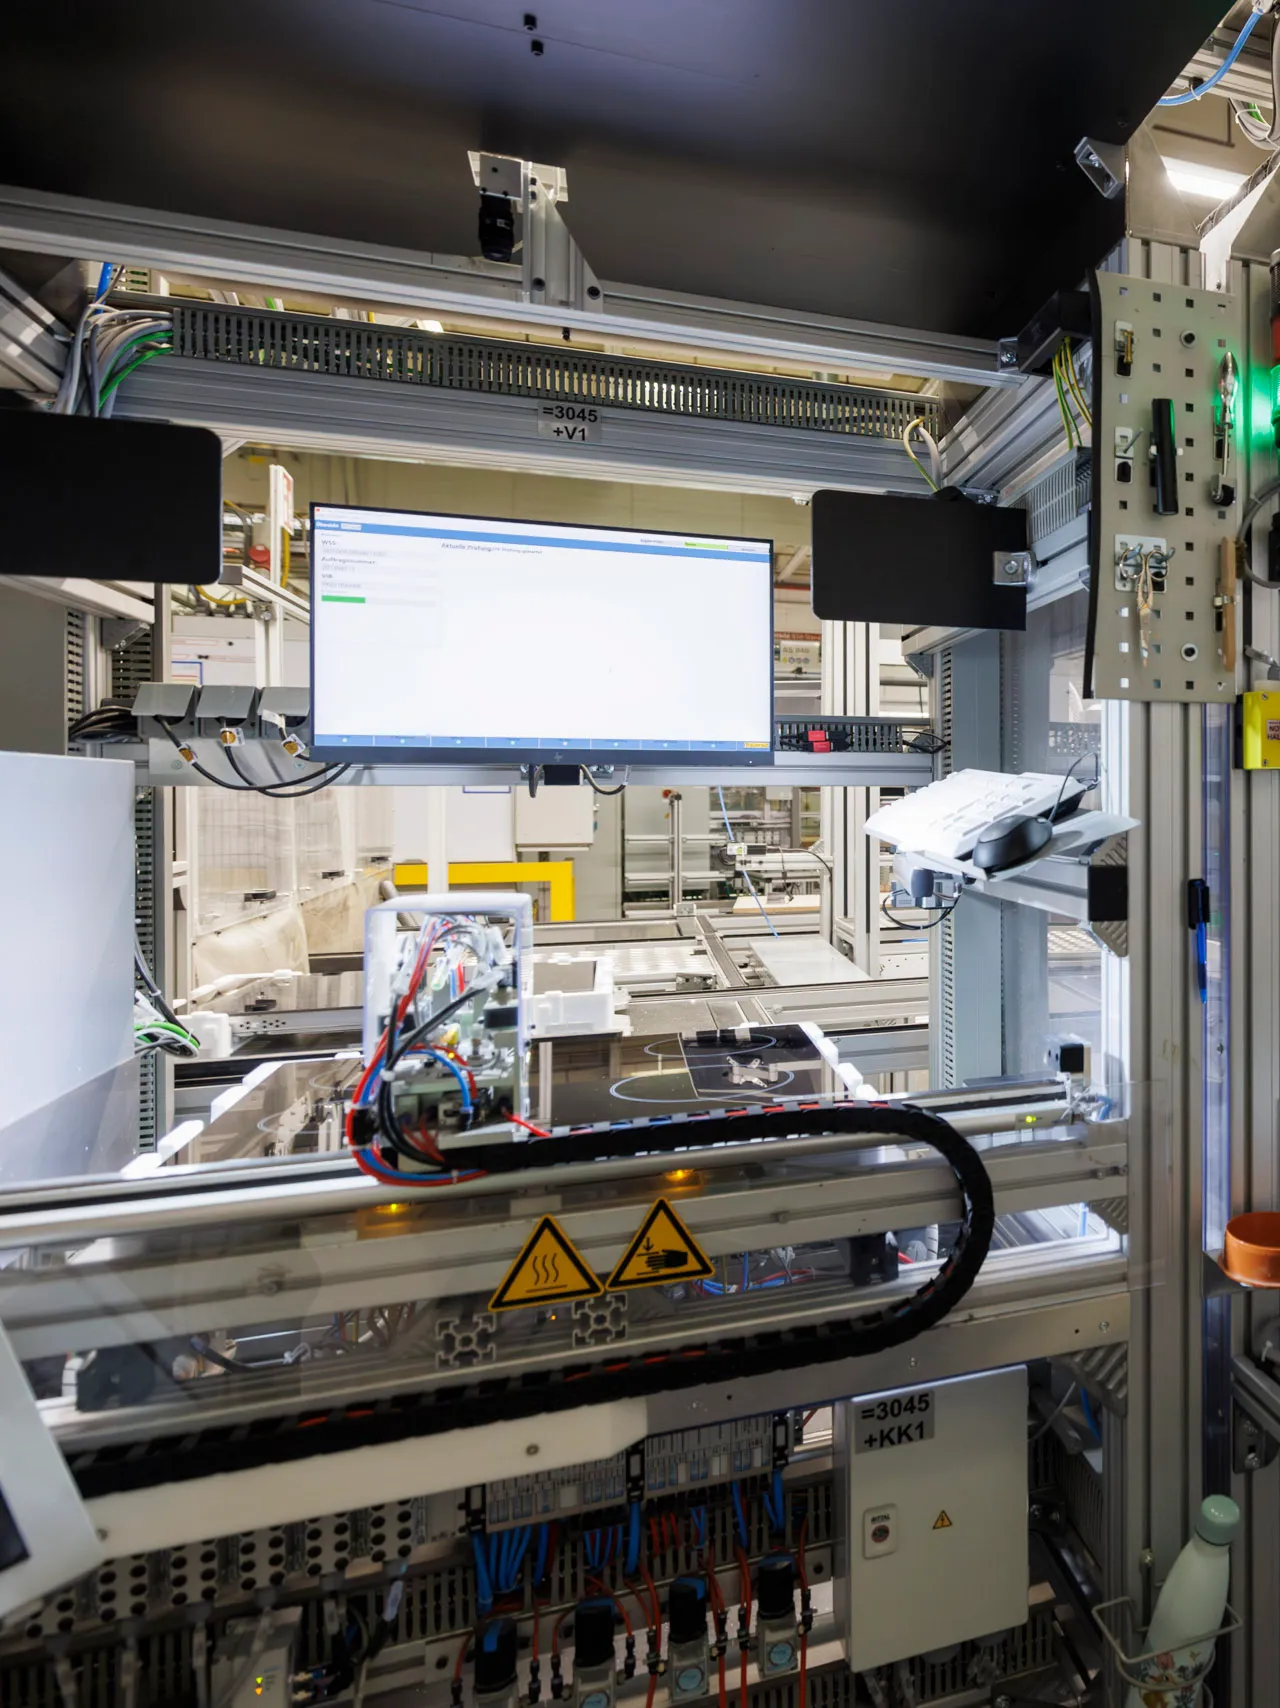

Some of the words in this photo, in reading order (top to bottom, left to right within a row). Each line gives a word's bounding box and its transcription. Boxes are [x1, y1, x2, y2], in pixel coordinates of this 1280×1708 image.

[542, 405, 598, 422] =3045
[553, 425, 586, 441] +V1
[861, 1393, 930, 1420] =3045
[864, 1421, 924, 1448] +KK1
